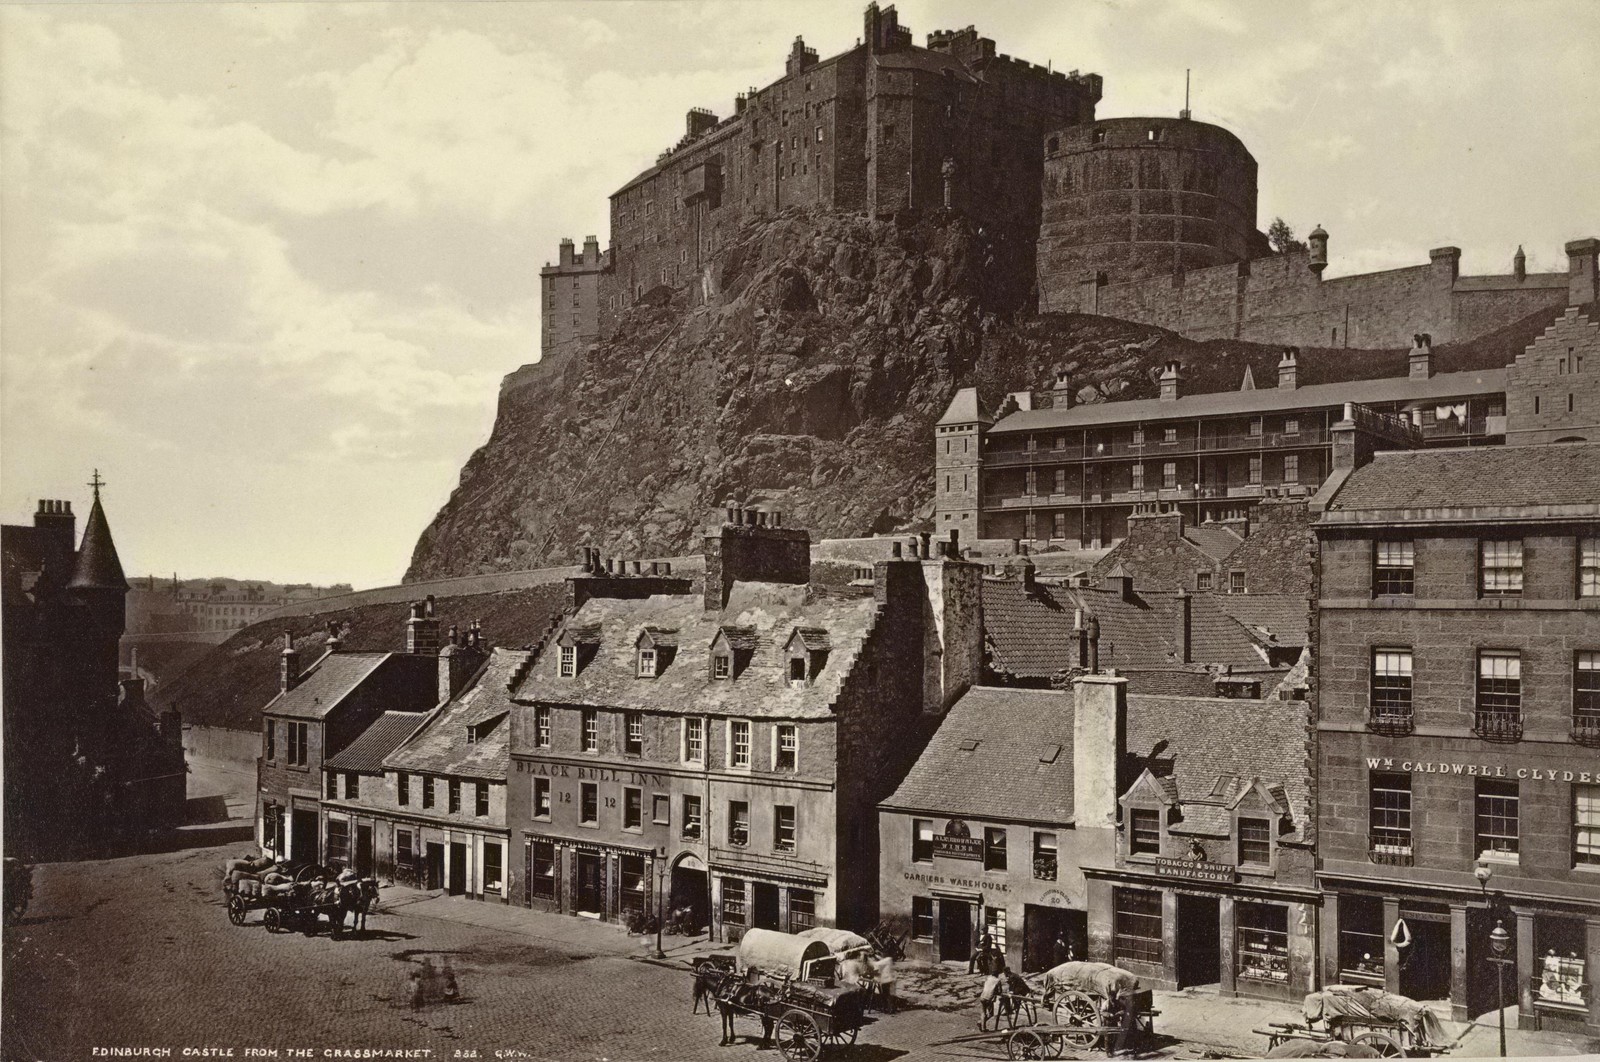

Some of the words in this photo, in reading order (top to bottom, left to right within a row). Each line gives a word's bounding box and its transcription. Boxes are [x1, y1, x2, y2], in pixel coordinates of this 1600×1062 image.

[516, 761, 569, 777] BLACK
[578, 767, 620, 782] BULL
[1402, 761, 1506, 777] CALDWELL
[559, 791, 572, 803] 12
[605, 796, 617, 807] 12
[1156, 858, 1194, 868] TOBACCO
[1203, 863, 1232, 872] SNUFF
[904, 872, 945, 884] CARRIERS
